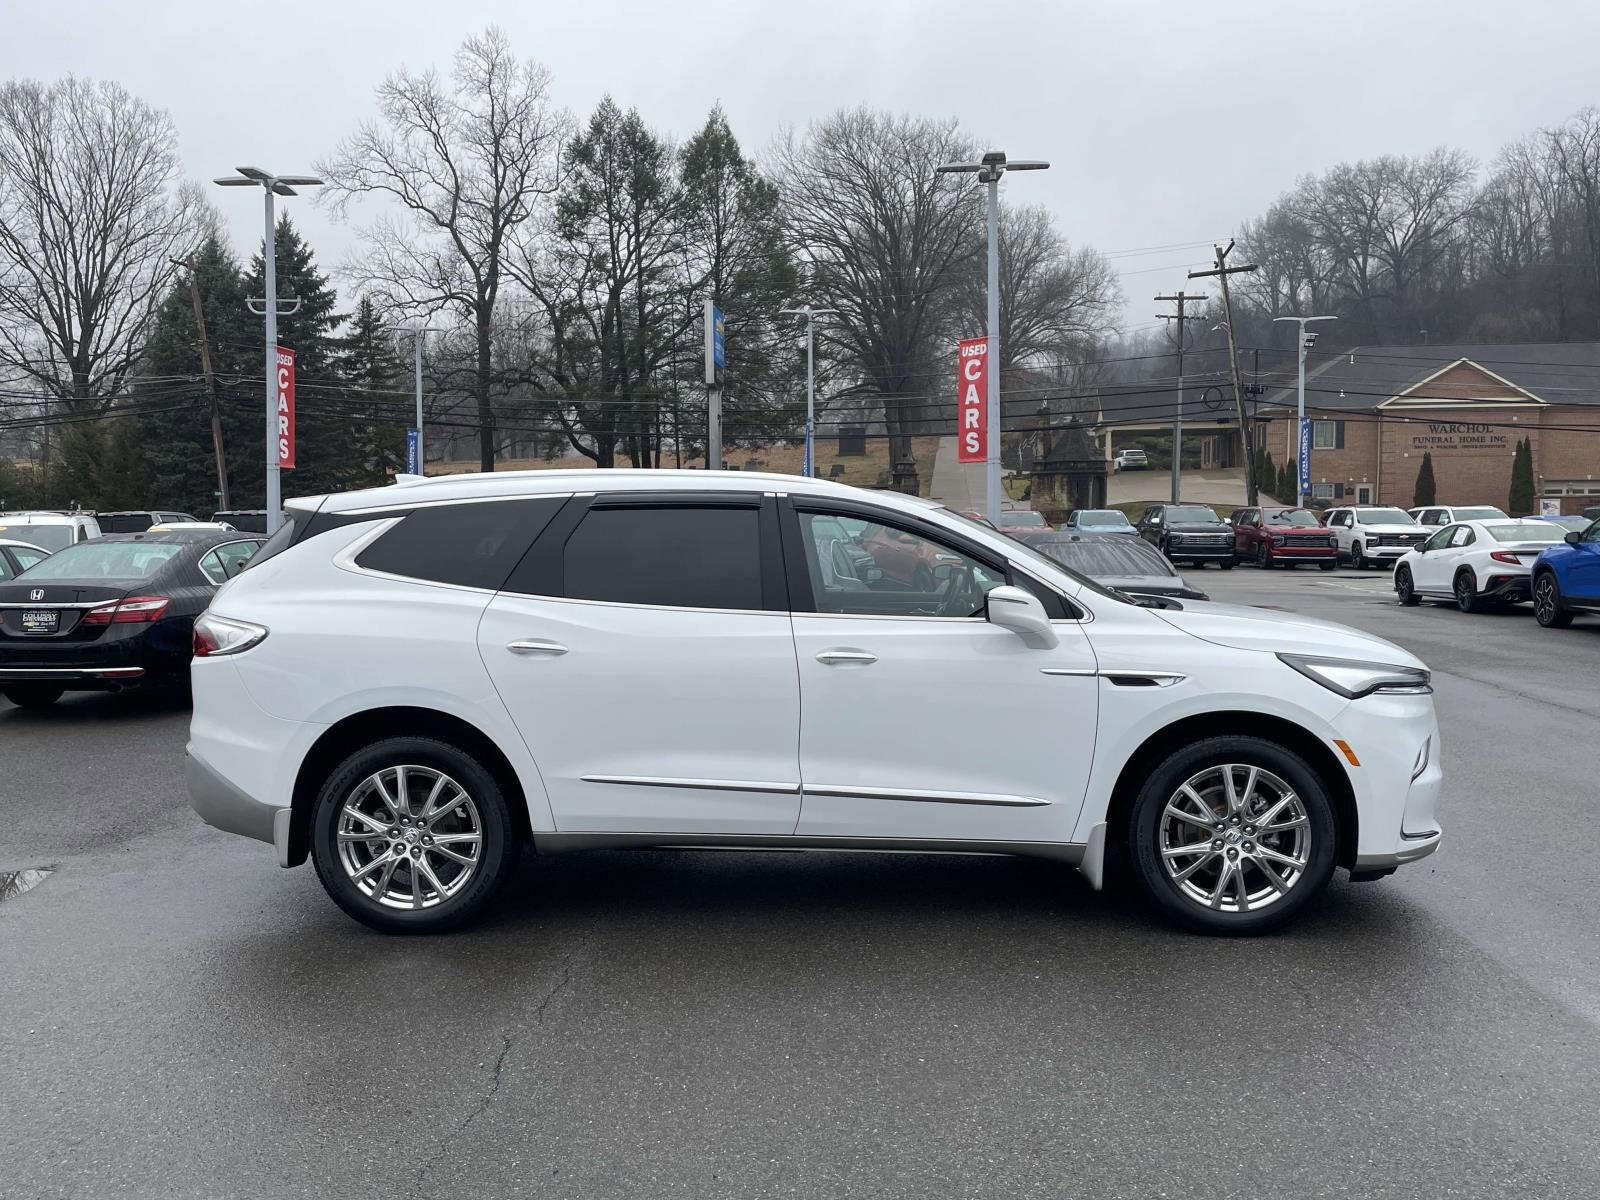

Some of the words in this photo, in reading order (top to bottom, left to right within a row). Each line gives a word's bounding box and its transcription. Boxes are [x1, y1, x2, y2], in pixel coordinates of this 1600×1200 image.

[962, 343, 987, 357] USED
[964, 359, 982, 453] CARS
[278, 368, 289, 459] CARS
[1429, 423, 1494, 434] WARCHOL
[1413, 436, 1456, 444] FUNERAL
[1459, 435, 1486, 443] HOME
